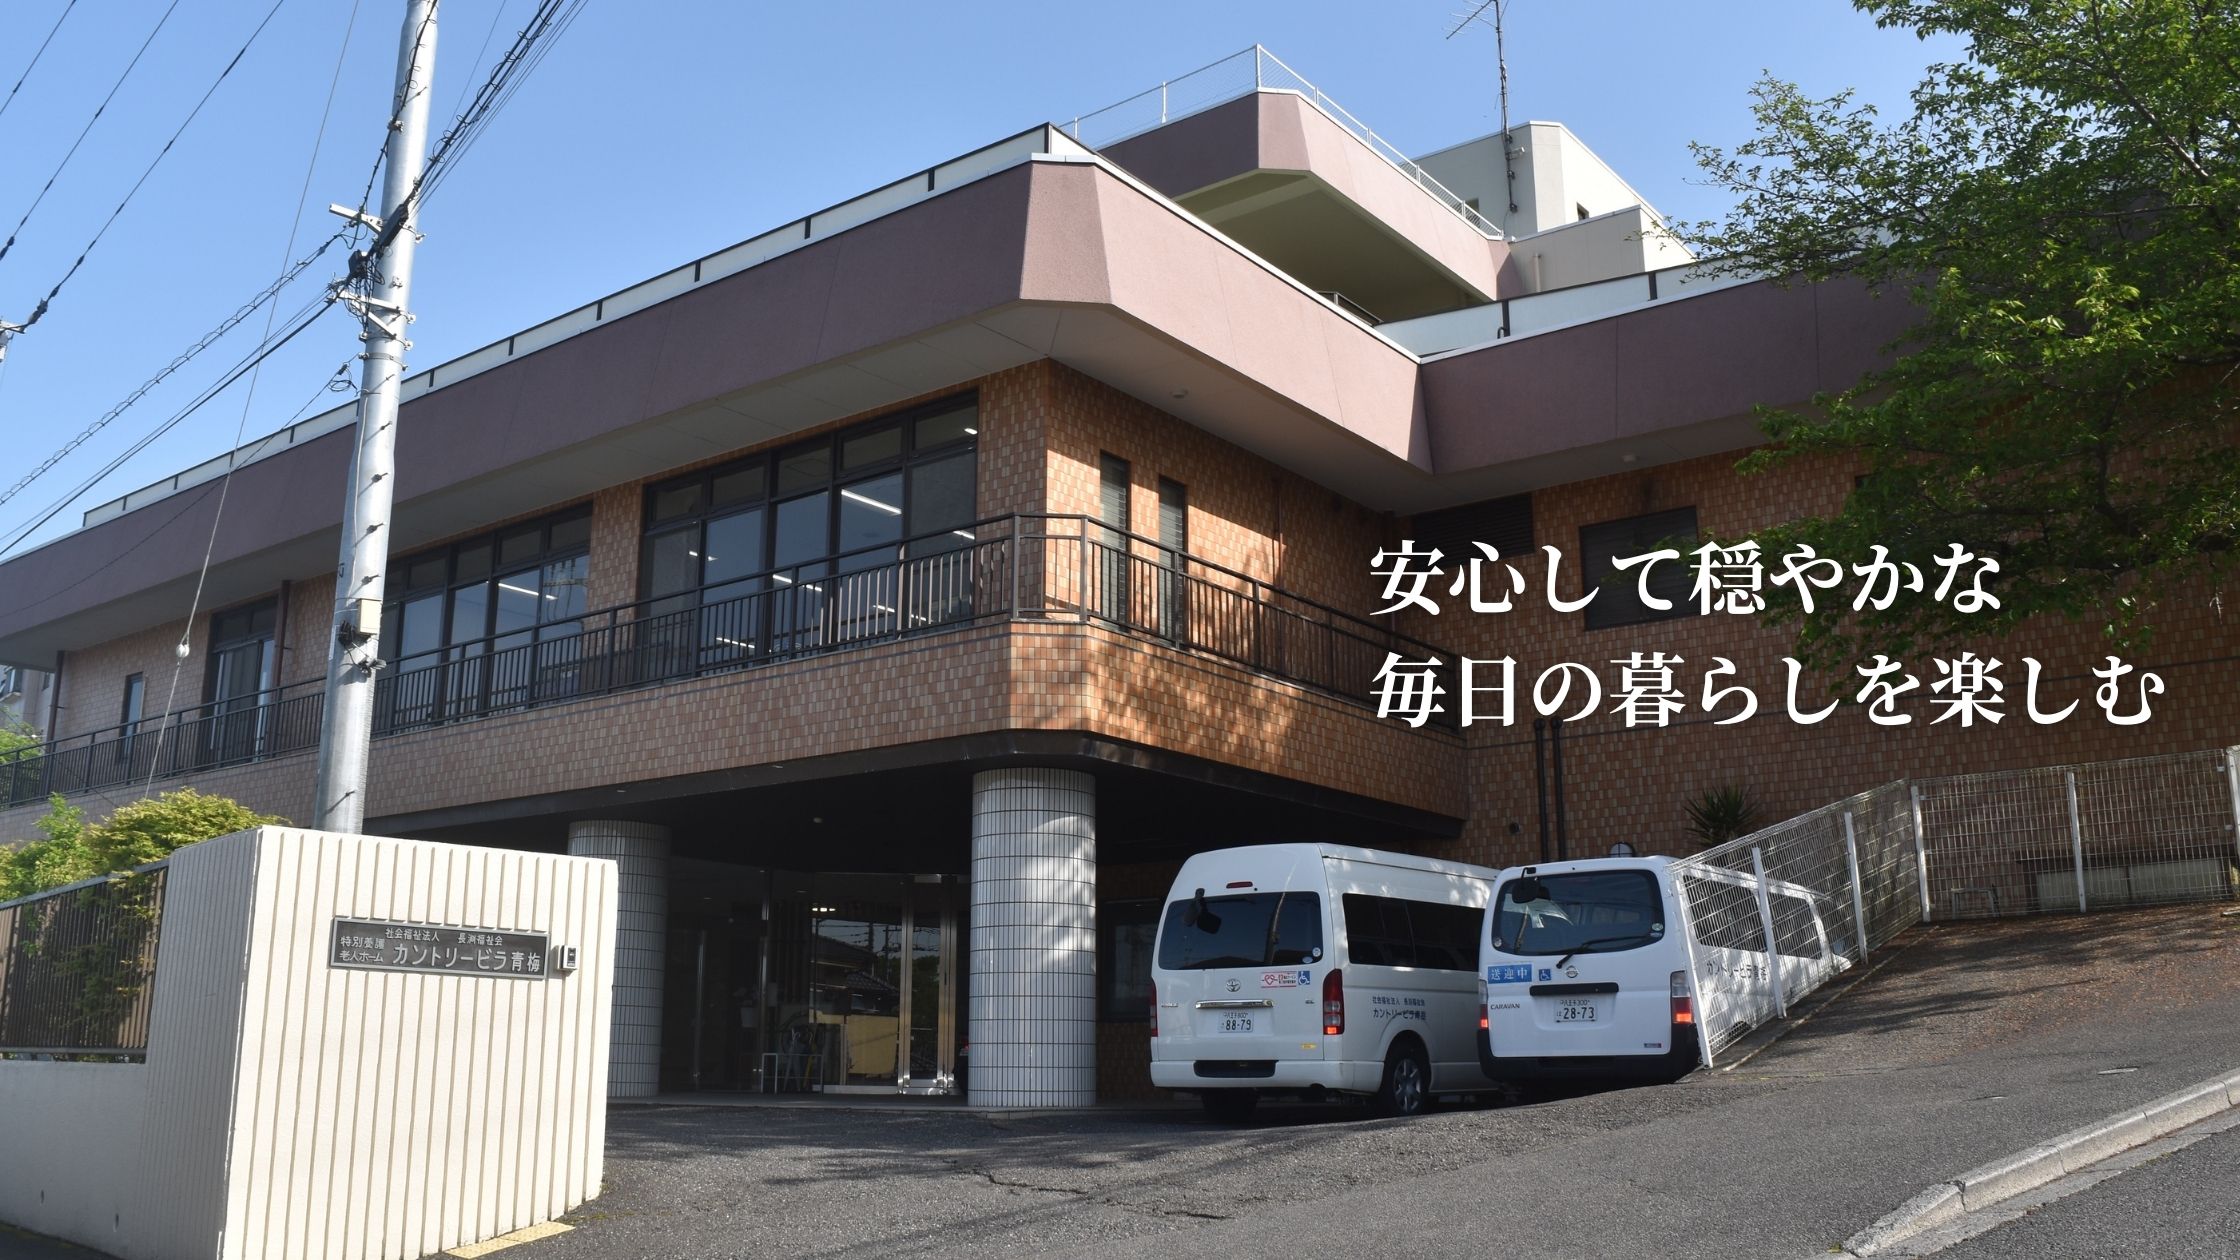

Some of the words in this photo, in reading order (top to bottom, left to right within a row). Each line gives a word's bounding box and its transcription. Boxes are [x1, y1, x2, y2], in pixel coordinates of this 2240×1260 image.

[385, 927, 440, 942] 社会福祉法人
[340, 935, 385, 950] 特別養護
[340, 950, 384, 963] 老人ホーム
[392, 943, 541, 972] カントリービラ青梅
[1491, 967, 1528, 981] 送迎中
[1706, 960, 1767, 981] カントリービラ
[1373, 1008, 1426, 1020] カントリービラ
[1563, 1006, 1595, 1020] 28-73
[1225, 1019, 1252, 1031] 88-79
